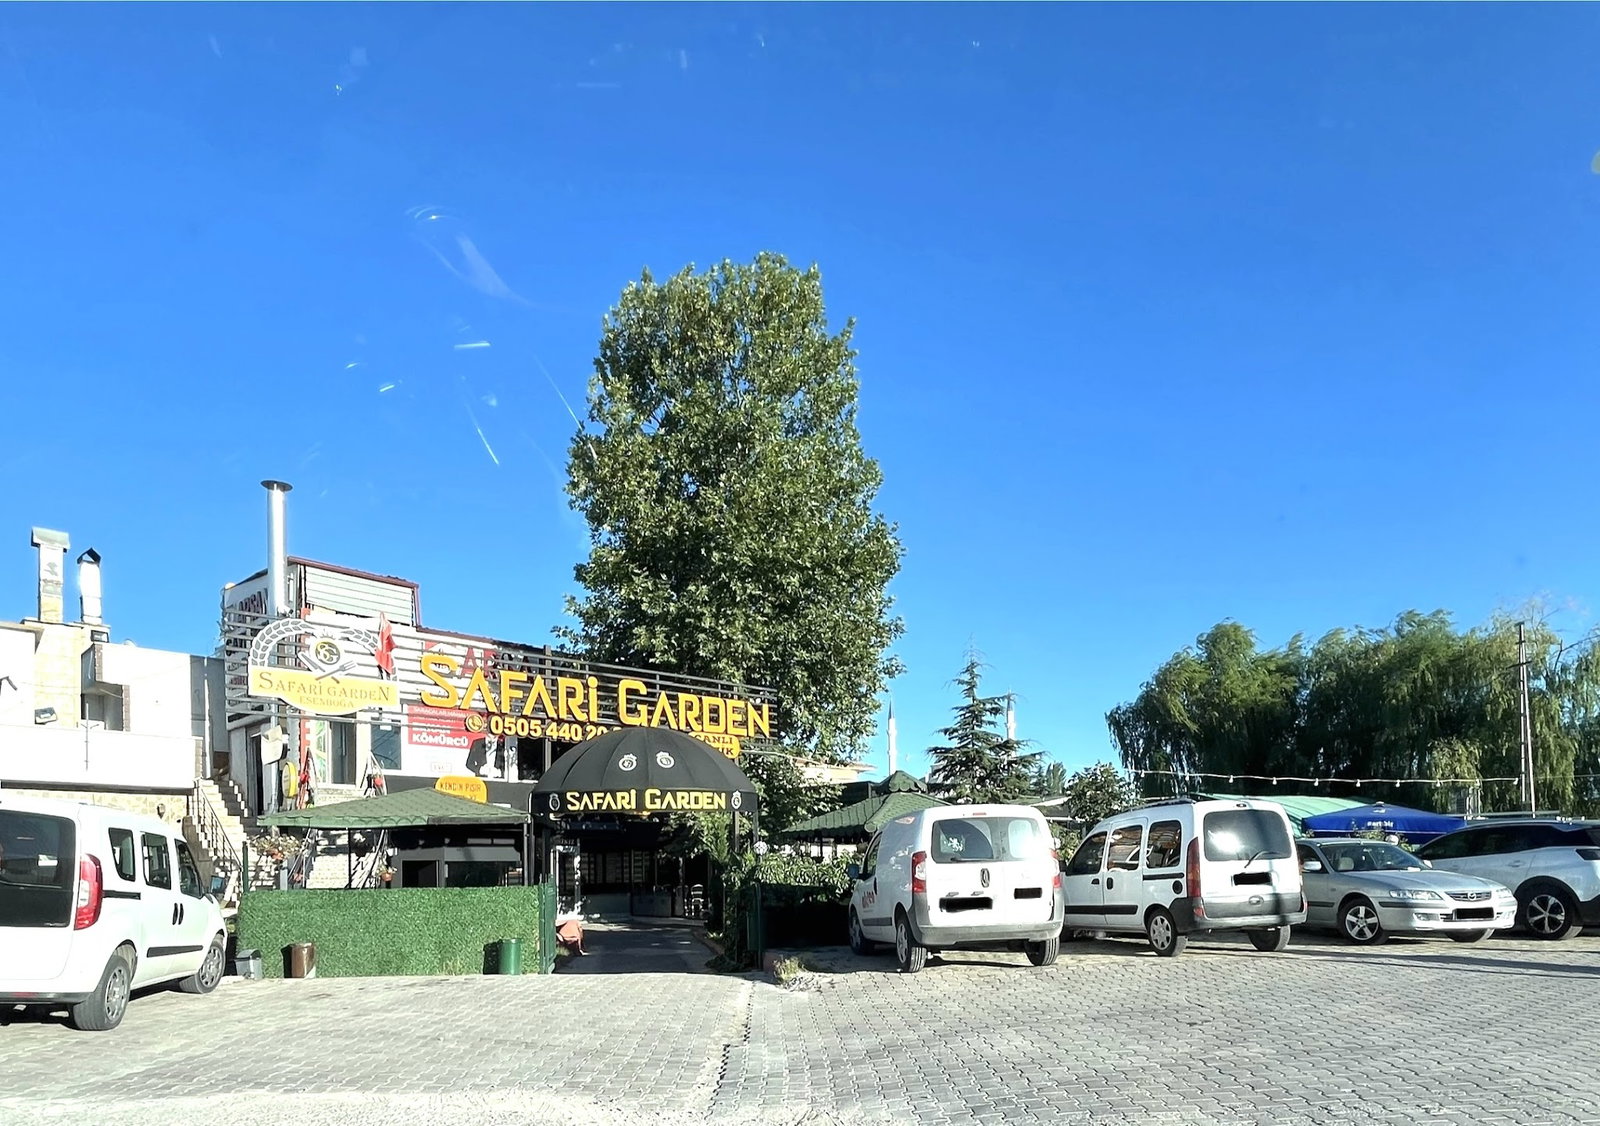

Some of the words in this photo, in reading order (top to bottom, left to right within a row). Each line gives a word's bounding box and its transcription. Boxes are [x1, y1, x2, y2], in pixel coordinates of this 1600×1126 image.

[327, 686, 390, 701] GARDEN
[617, 679, 770, 738] GARDEN
[490, 715, 542, 738] 0505
[546, 721, 582, 741] 440
[644, 788, 726, 810] GARDEN
